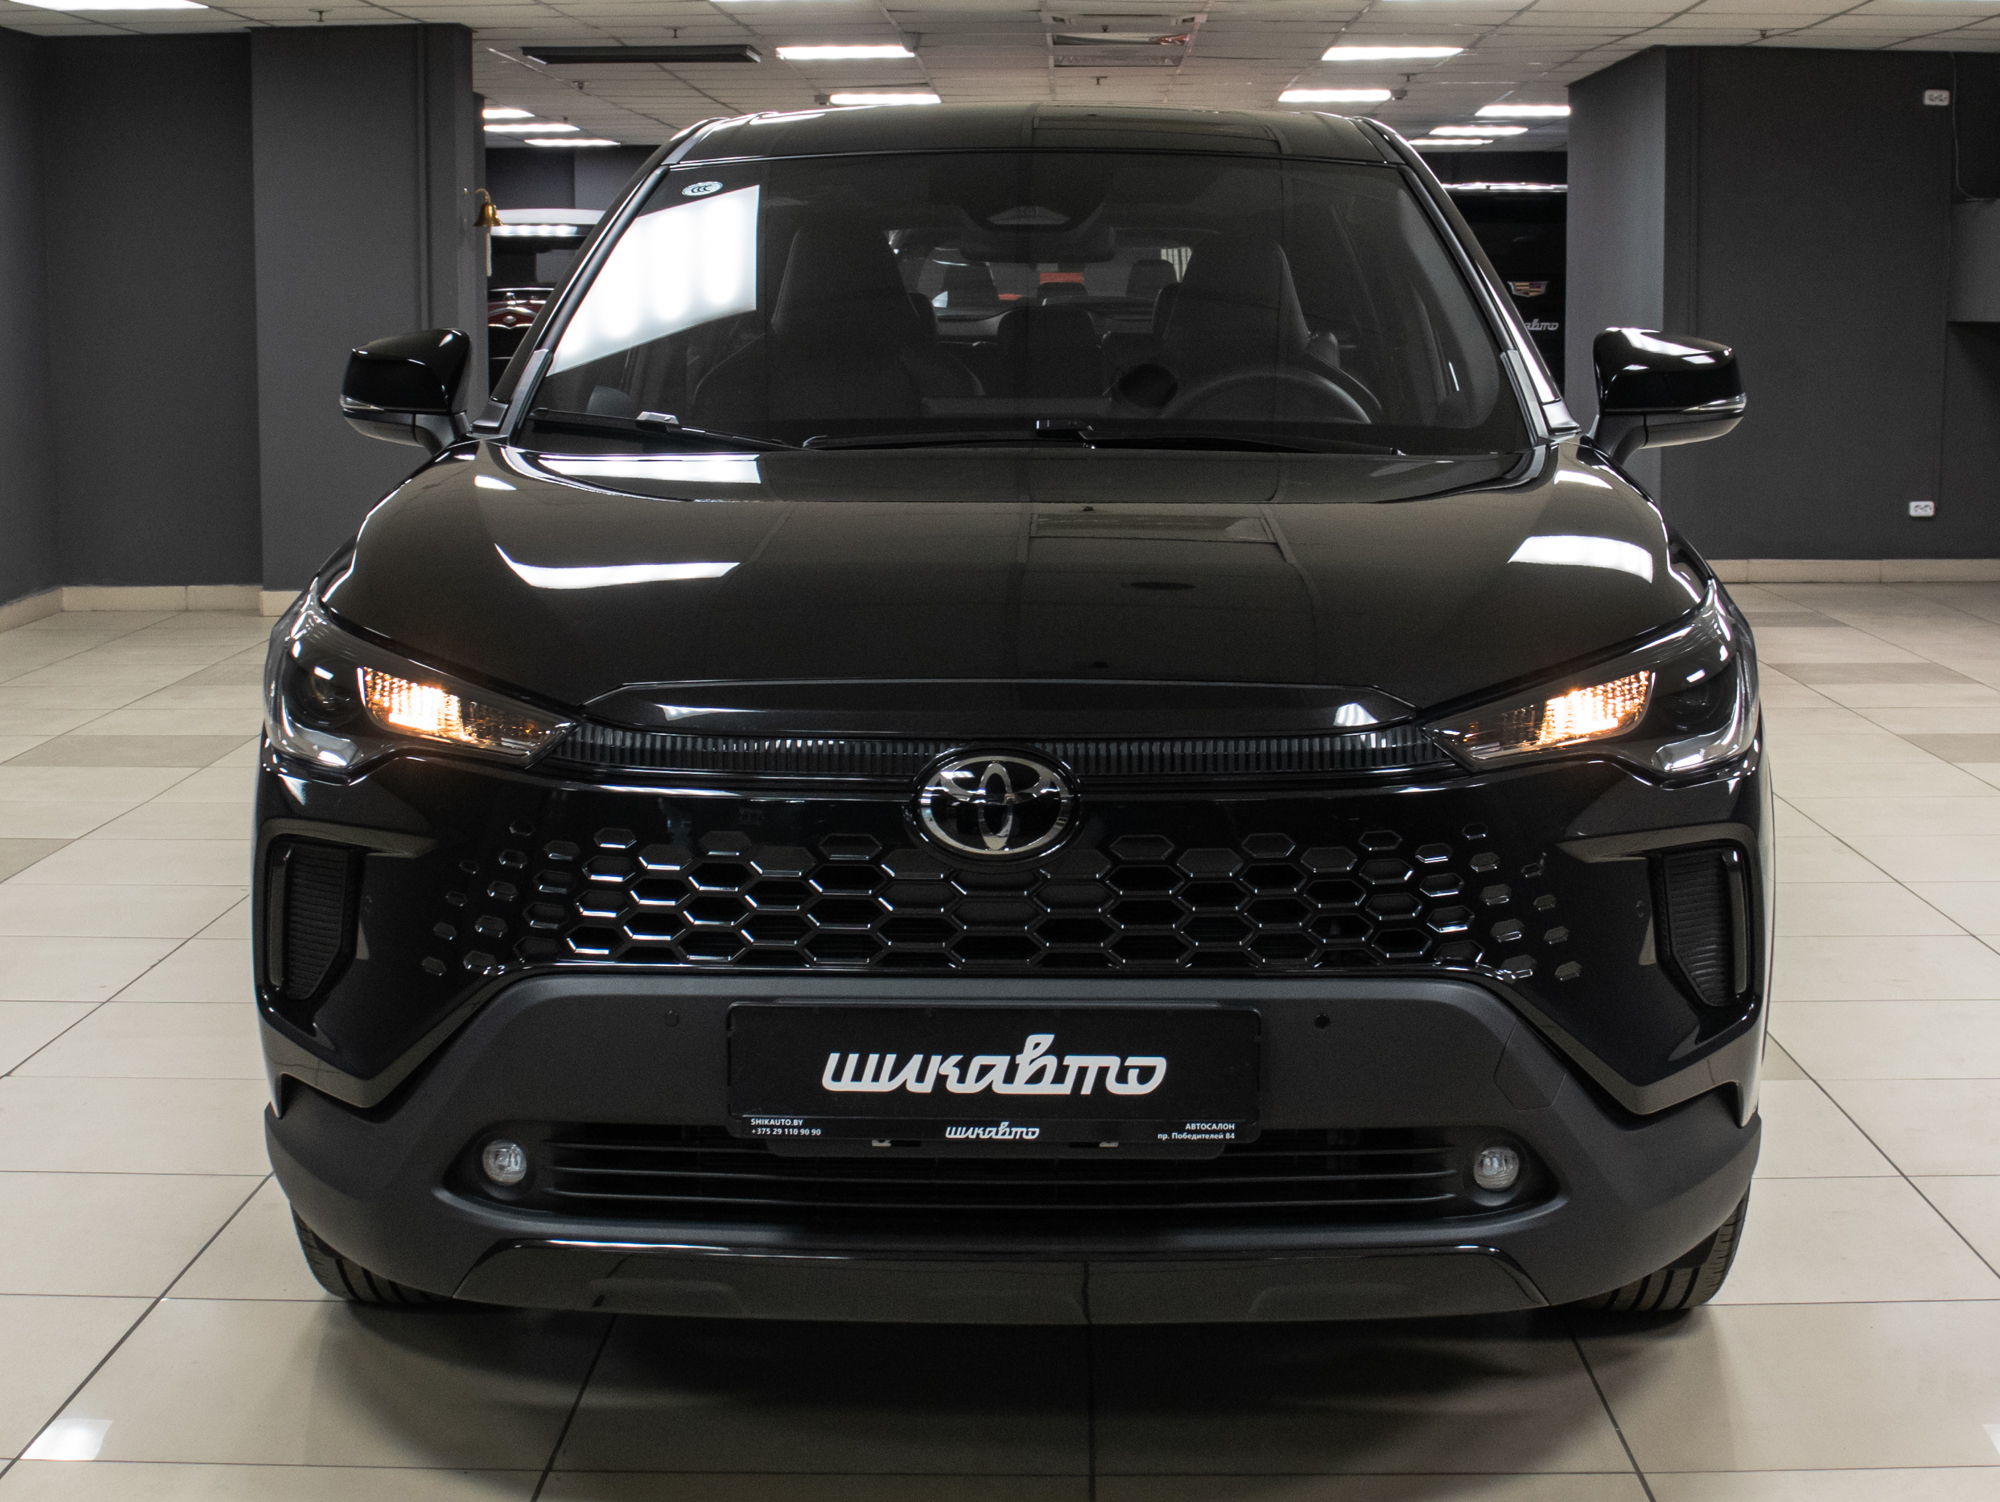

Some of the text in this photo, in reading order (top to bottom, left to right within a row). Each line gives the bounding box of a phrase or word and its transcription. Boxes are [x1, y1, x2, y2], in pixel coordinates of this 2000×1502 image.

[822, 1033, 1166, 1095] шикавто
[750, 1118, 803, 1126] SHIKAUTO.BY
[751, 1127, 771, 1135] +375
[800, 1128, 810, 1136] 90
[945, 1121, 1040, 1139] шикавто
[1157, 1133, 1170, 1141] пр.
[1171, 1132, 1224, 1140] Победителей
